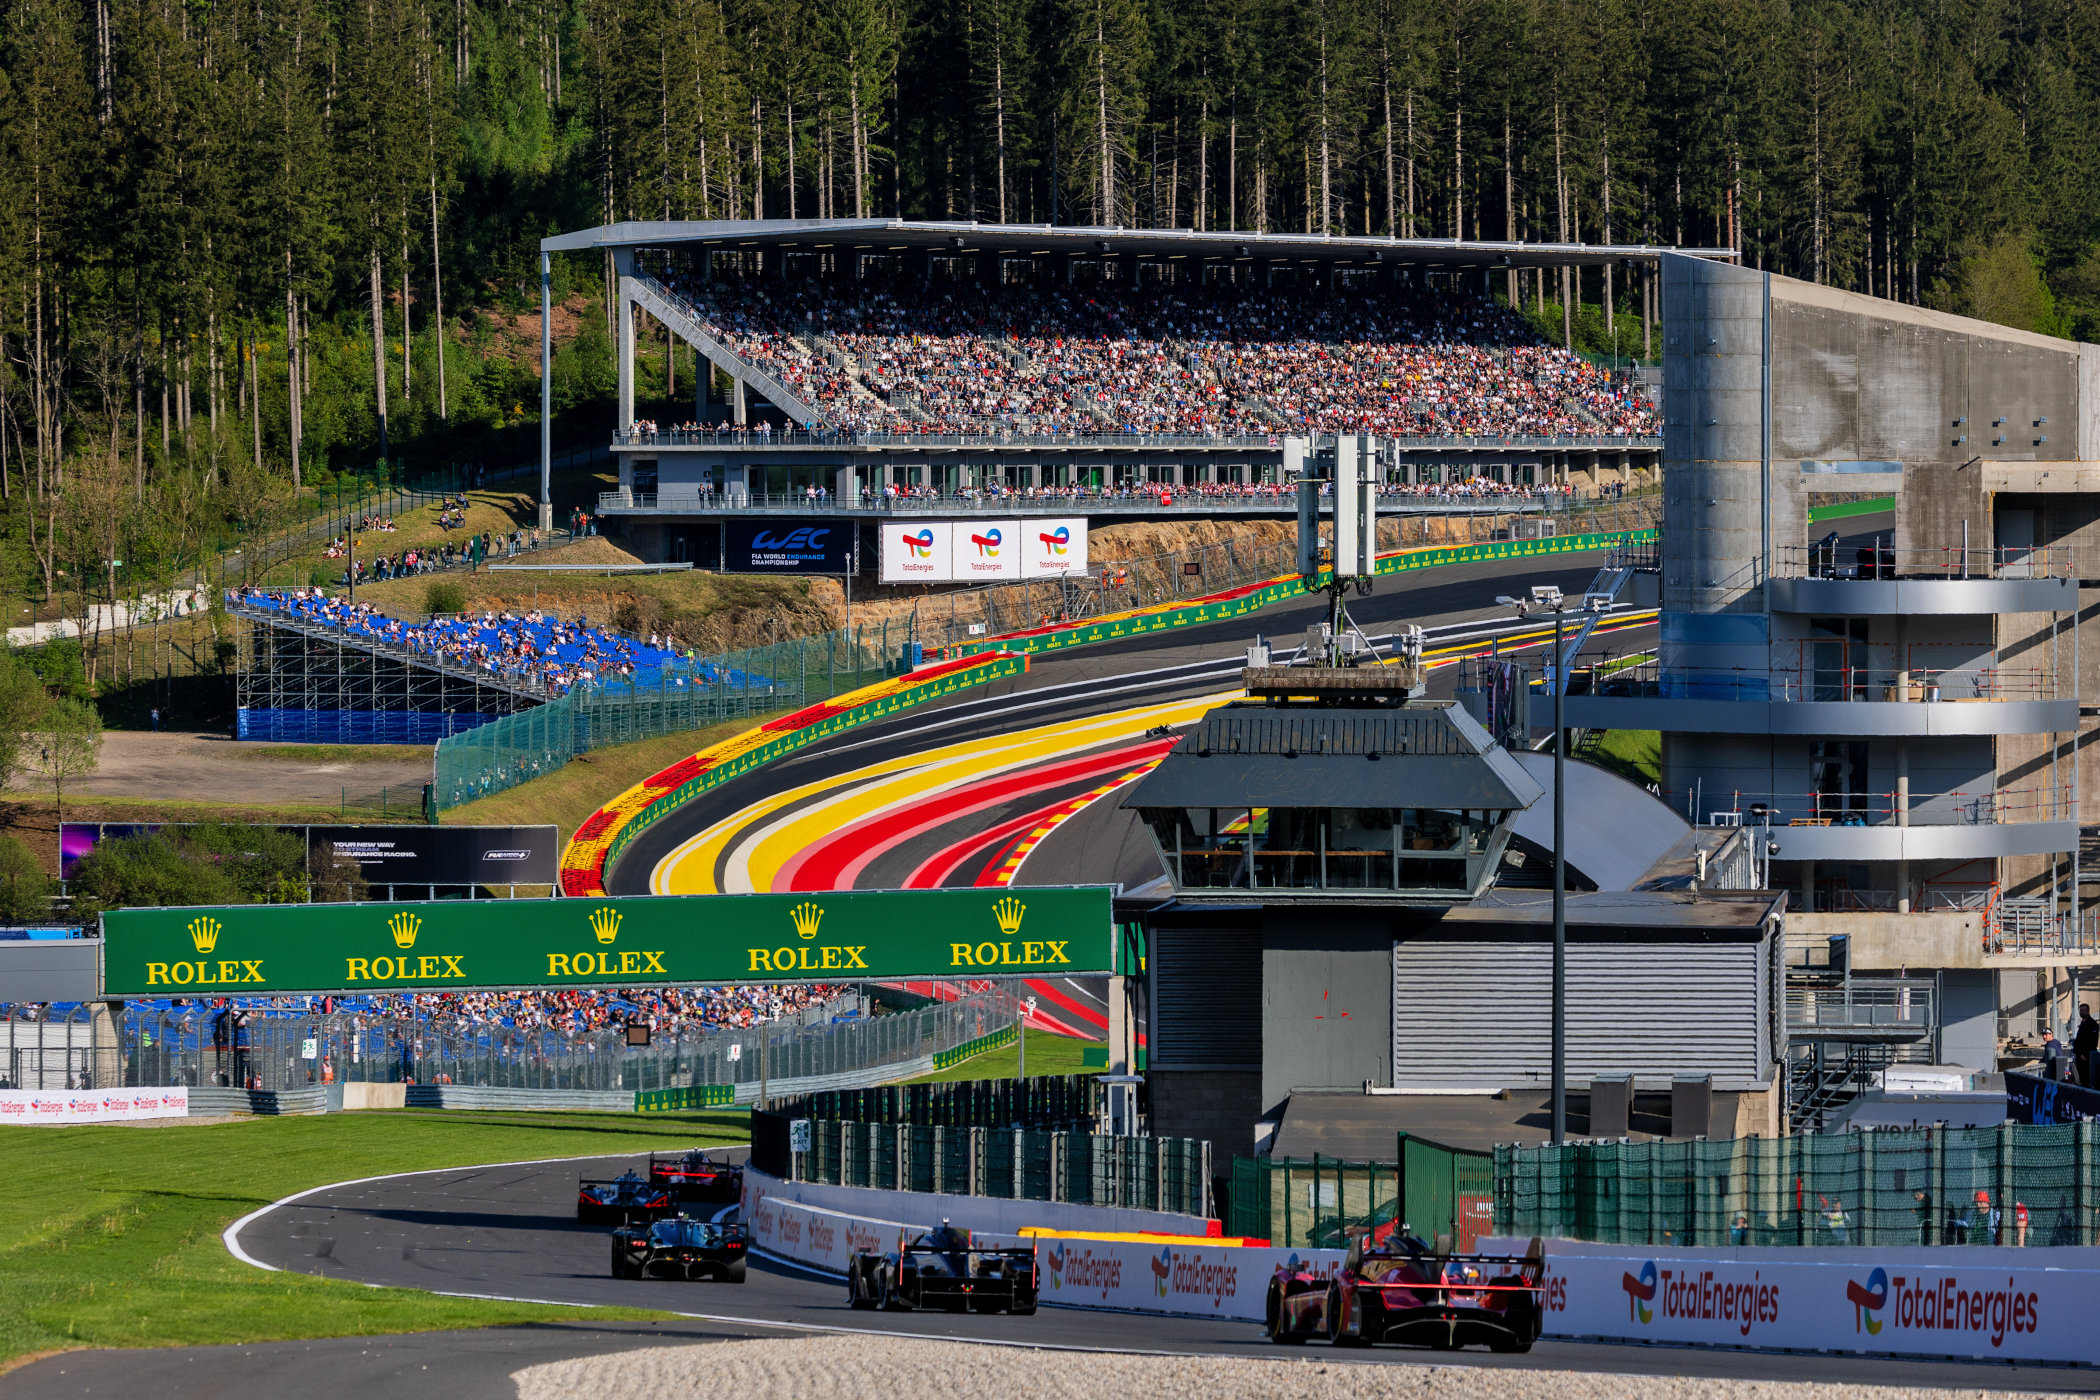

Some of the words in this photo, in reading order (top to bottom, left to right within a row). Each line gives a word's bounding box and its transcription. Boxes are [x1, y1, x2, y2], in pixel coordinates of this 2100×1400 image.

[752, 527, 831, 550] WEC
[902, 563, 934, 573] TotalEnergies
[971, 562, 1002, 572] TotalEnergies
[1039, 561, 1070, 570] TotalEnergies
[547, 952, 666, 975] ROLEX
[748, 947, 868, 970] ROLEX
[951, 941, 1071, 965] ROLEX
[147, 961, 265, 984] ROLEX
[347, 956, 466, 980] ROLEX
[1065, 1247, 1122, 1300] TotalEnergies
[1172, 1253, 1238, 1308] TotalEnergies
[1660, 1269, 1779, 1337] TotalEnergies
[1892, 1275, 2039, 1348] TotalEnergies
